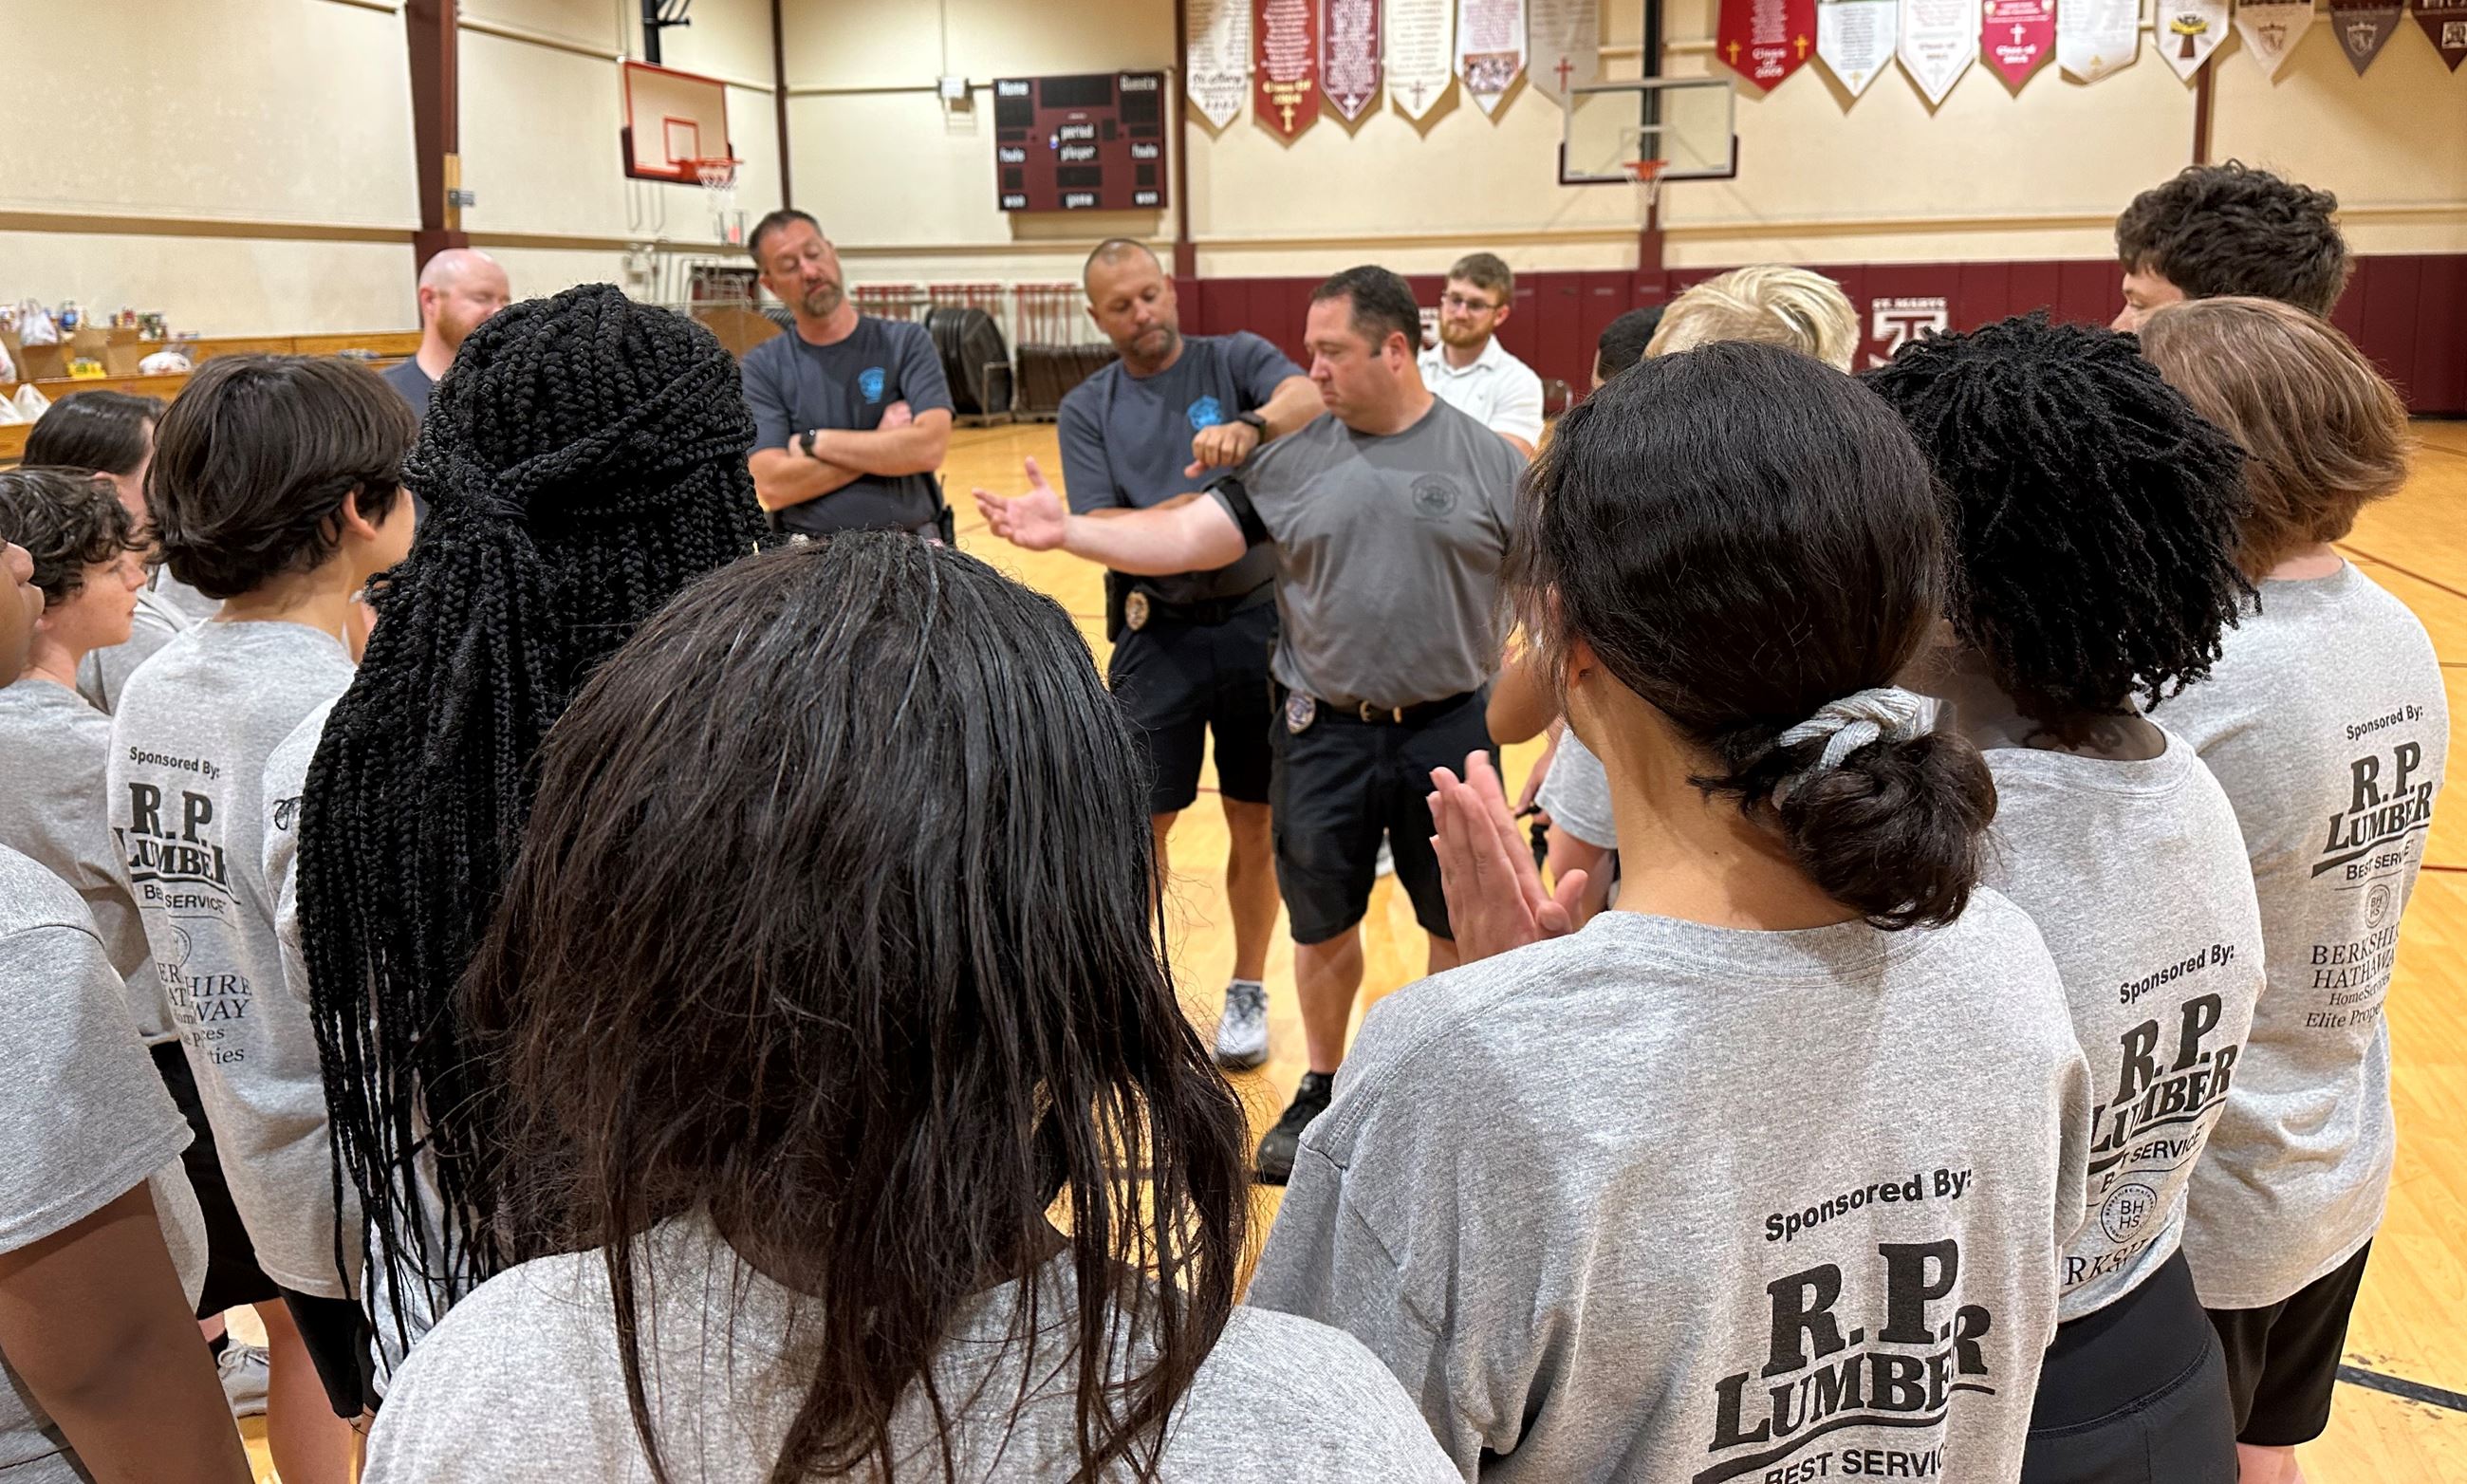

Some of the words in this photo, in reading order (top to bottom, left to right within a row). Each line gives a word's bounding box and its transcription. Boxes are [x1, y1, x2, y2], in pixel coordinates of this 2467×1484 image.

[998, 80, 1029, 97] Home
[1059, 123, 1094, 141] period
[1059, 144, 1096, 162] player
[2346, 710, 2403, 741] Sponsored
[2406, 704, 2423, 722] By:
[129, 746, 199, 773] Sponsored
[202, 760, 220, 780] By:
[2323, 781, 2433, 854] LUMBER
[2346, 859, 2373, 881] BEST
[2310, 921, 2400, 965] BERKSHI
[2120, 949, 2205, 1004] Sponsored
[2211, 943, 2235, 966] By:
[2311, 947, 2394, 989] HATHAWA
[2306, 1012, 2346, 1028] Elite
[1765, 1174, 1923, 1242] Sponsored
[1933, 1168, 1972, 1198] By:
[2121, 1199, 2144, 1215] BH
[2119, 1215, 2141, 1230] HS
[1708, 1305, 1992, 1453] LUMBER
